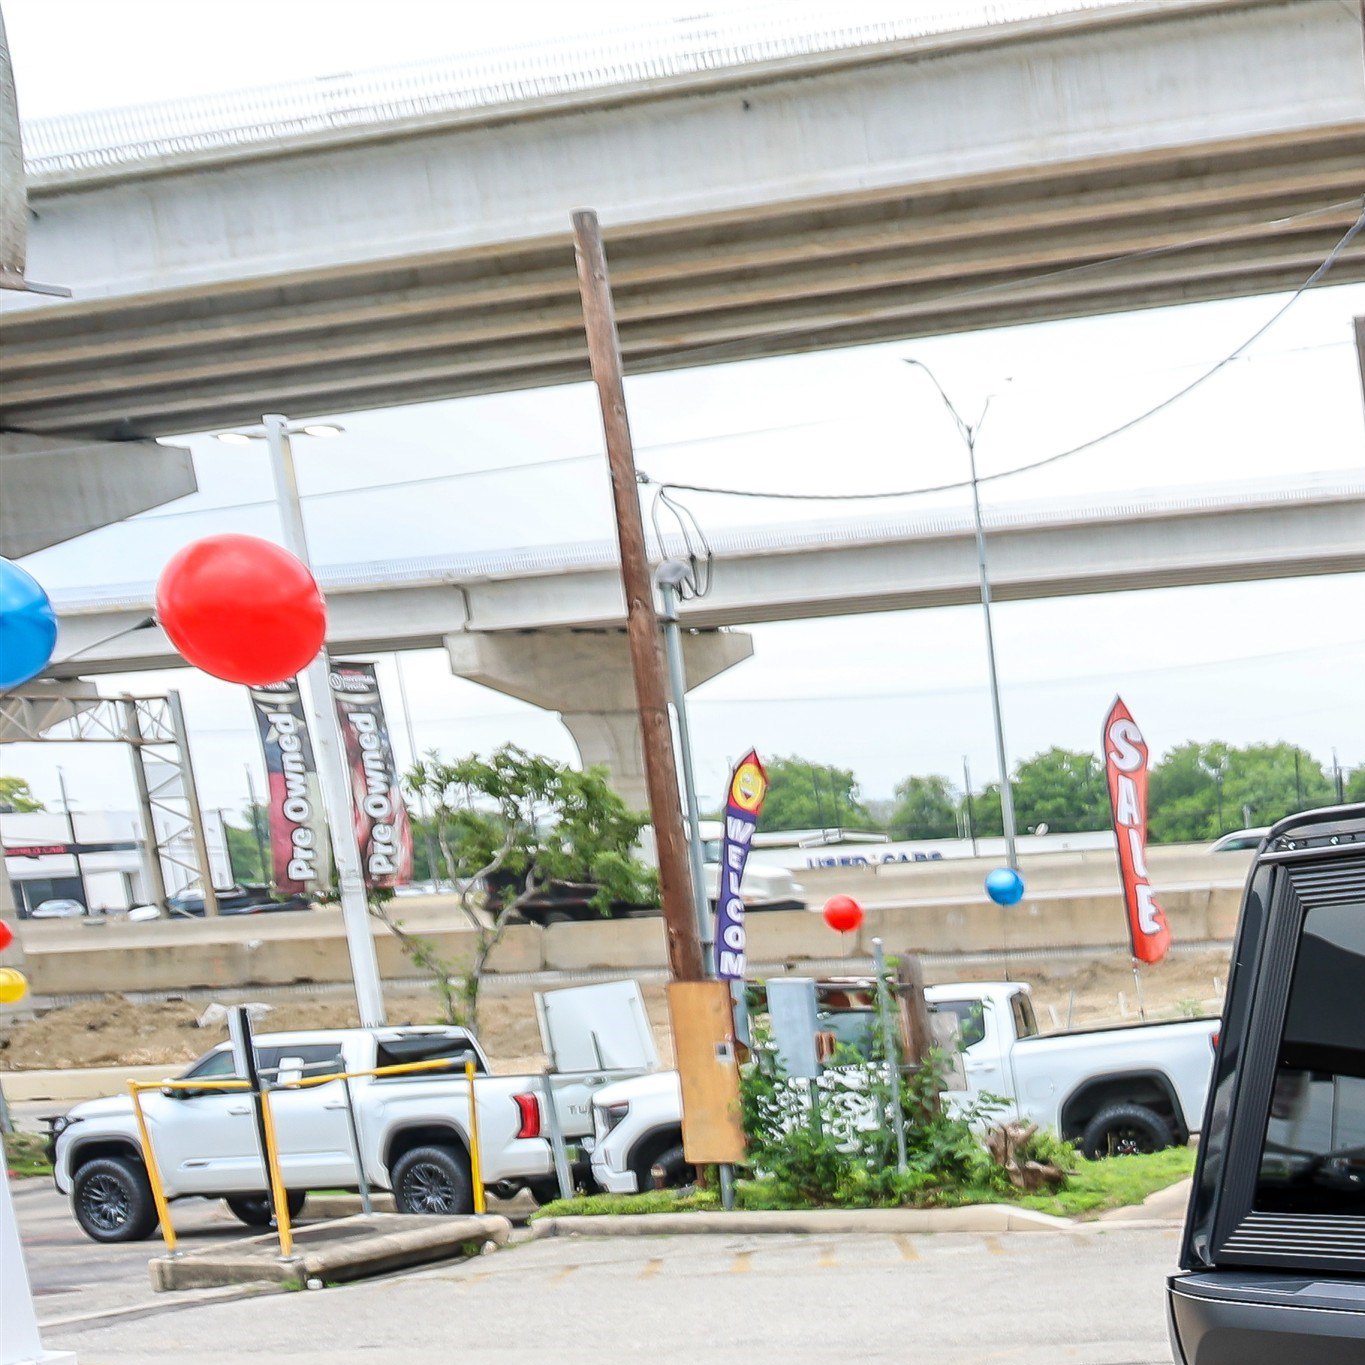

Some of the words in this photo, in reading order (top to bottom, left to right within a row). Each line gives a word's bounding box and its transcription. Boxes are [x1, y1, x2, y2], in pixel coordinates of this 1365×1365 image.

[267, 713, 311, 823] Owned
[348, 712, 392, 819] Owned
[288, 827, 317, 881] Pre
[368, 823, 399, 876] Pre
[1108, 718, 1162, 935] SALE
